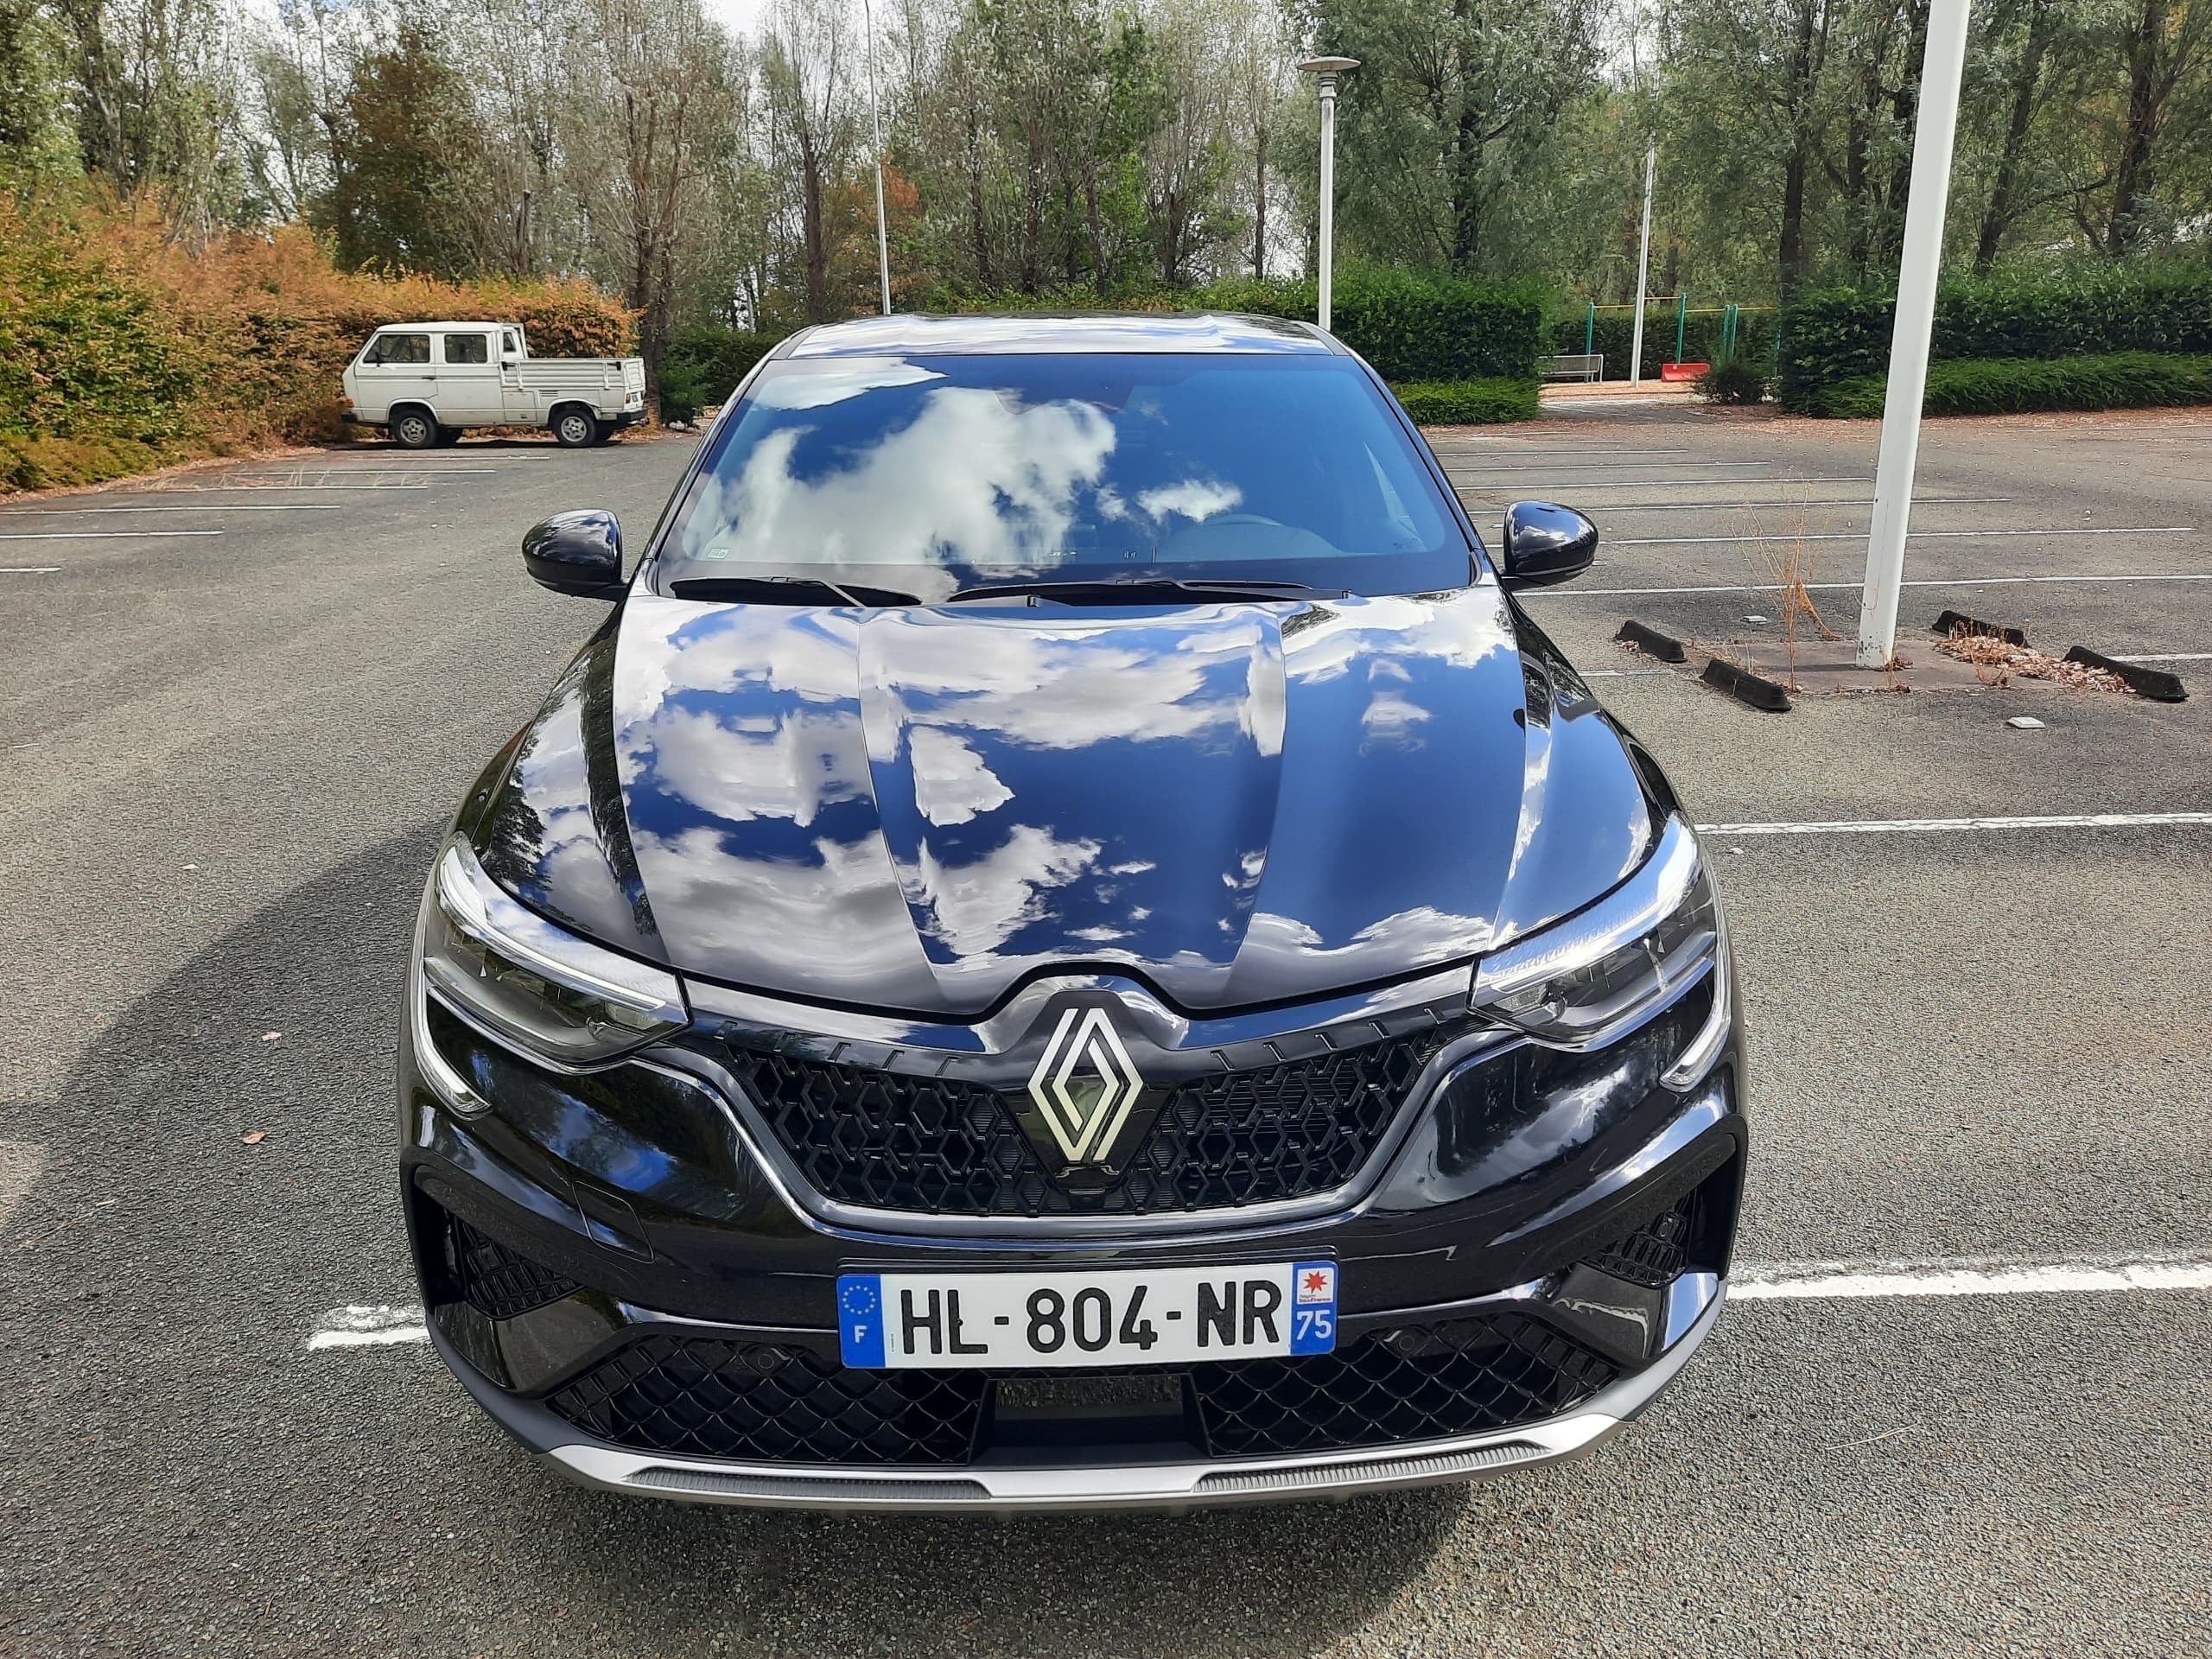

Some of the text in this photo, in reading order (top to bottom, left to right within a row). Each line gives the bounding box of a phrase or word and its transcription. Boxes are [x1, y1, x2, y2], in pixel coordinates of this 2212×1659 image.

[900, 1280, 1282, 1355] HL-804-NR
[1296, 1309, 1332, 1341] 75
[854, 1325, 868, 1344] F
